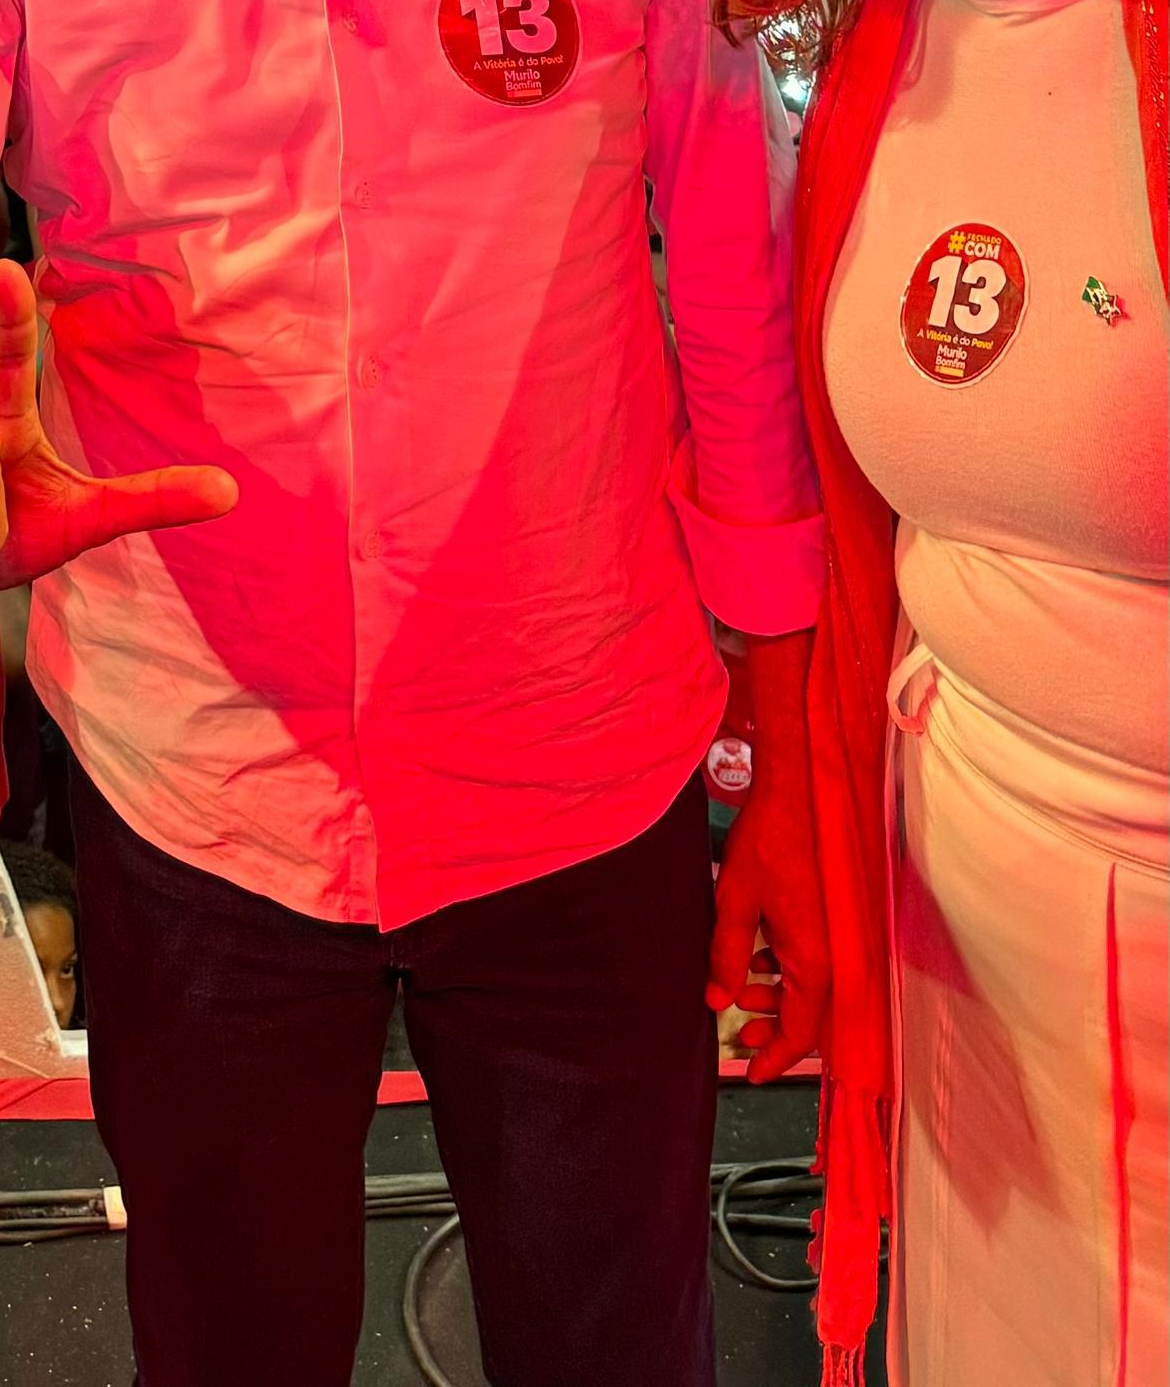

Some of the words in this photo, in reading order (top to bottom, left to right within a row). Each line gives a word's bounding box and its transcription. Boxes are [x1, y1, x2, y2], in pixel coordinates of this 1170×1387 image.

[473, 61, 482, 70] A
[483, 58, 516, 70] Vitória
[526, 56, 538, 66] do
[504, 69, 540, 81] Murilo
[506, 80, 541, 91] Bomfim
[928, 255, 1006, 335] 13
[917, 328, 924, 338] A
[926, 329, 951, 343] Vitória
[959, 336, 970, 346] do
[937, 344, 967, 360] Murilo
[936, 355, 965, 369] Bomfim
